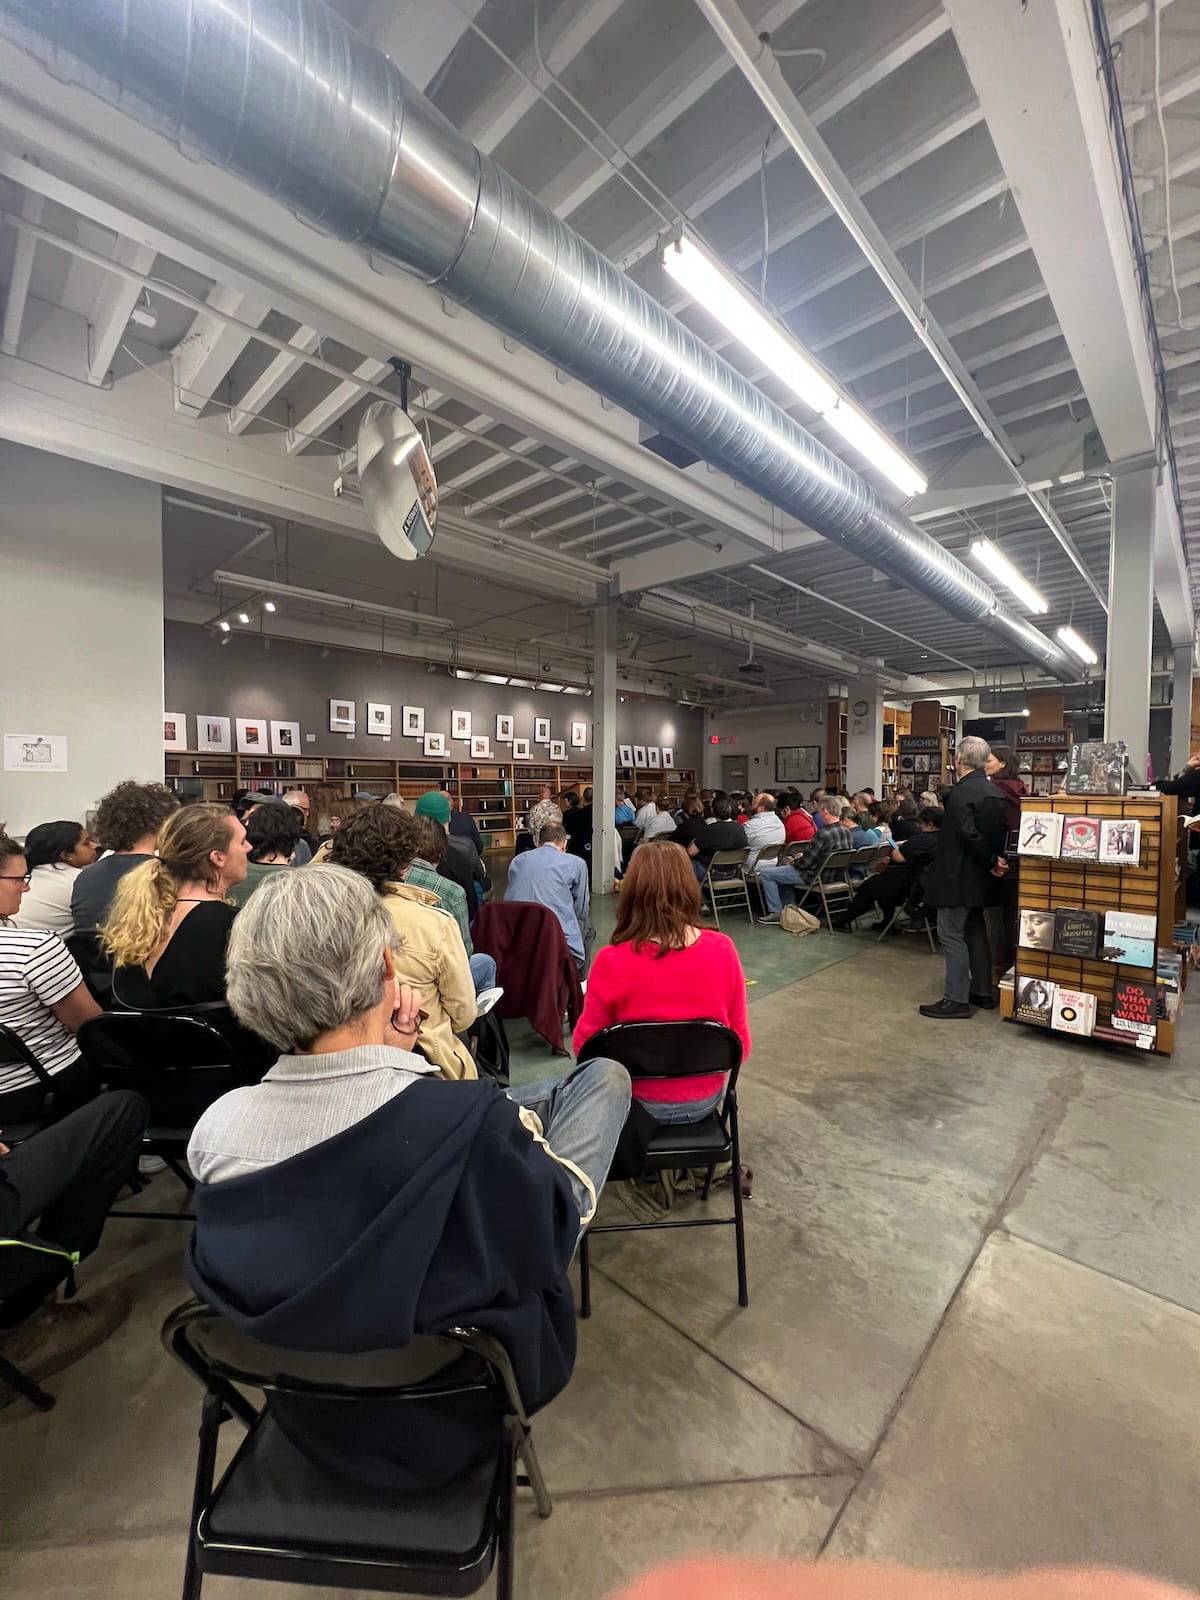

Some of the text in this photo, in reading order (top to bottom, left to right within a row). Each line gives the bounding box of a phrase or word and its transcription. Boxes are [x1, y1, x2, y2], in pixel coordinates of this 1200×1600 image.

[902, 739, 938, 747] TASCHEN
[1020, 735, 1065, 744] TASCHEN
[1126, 986, 1144, 996] DO
[1118, 993, 1152, 1006] WHAT
[1122, 1002, 1147, 1013] YOU
[1117, 1010, 1152, 1023] WANT
